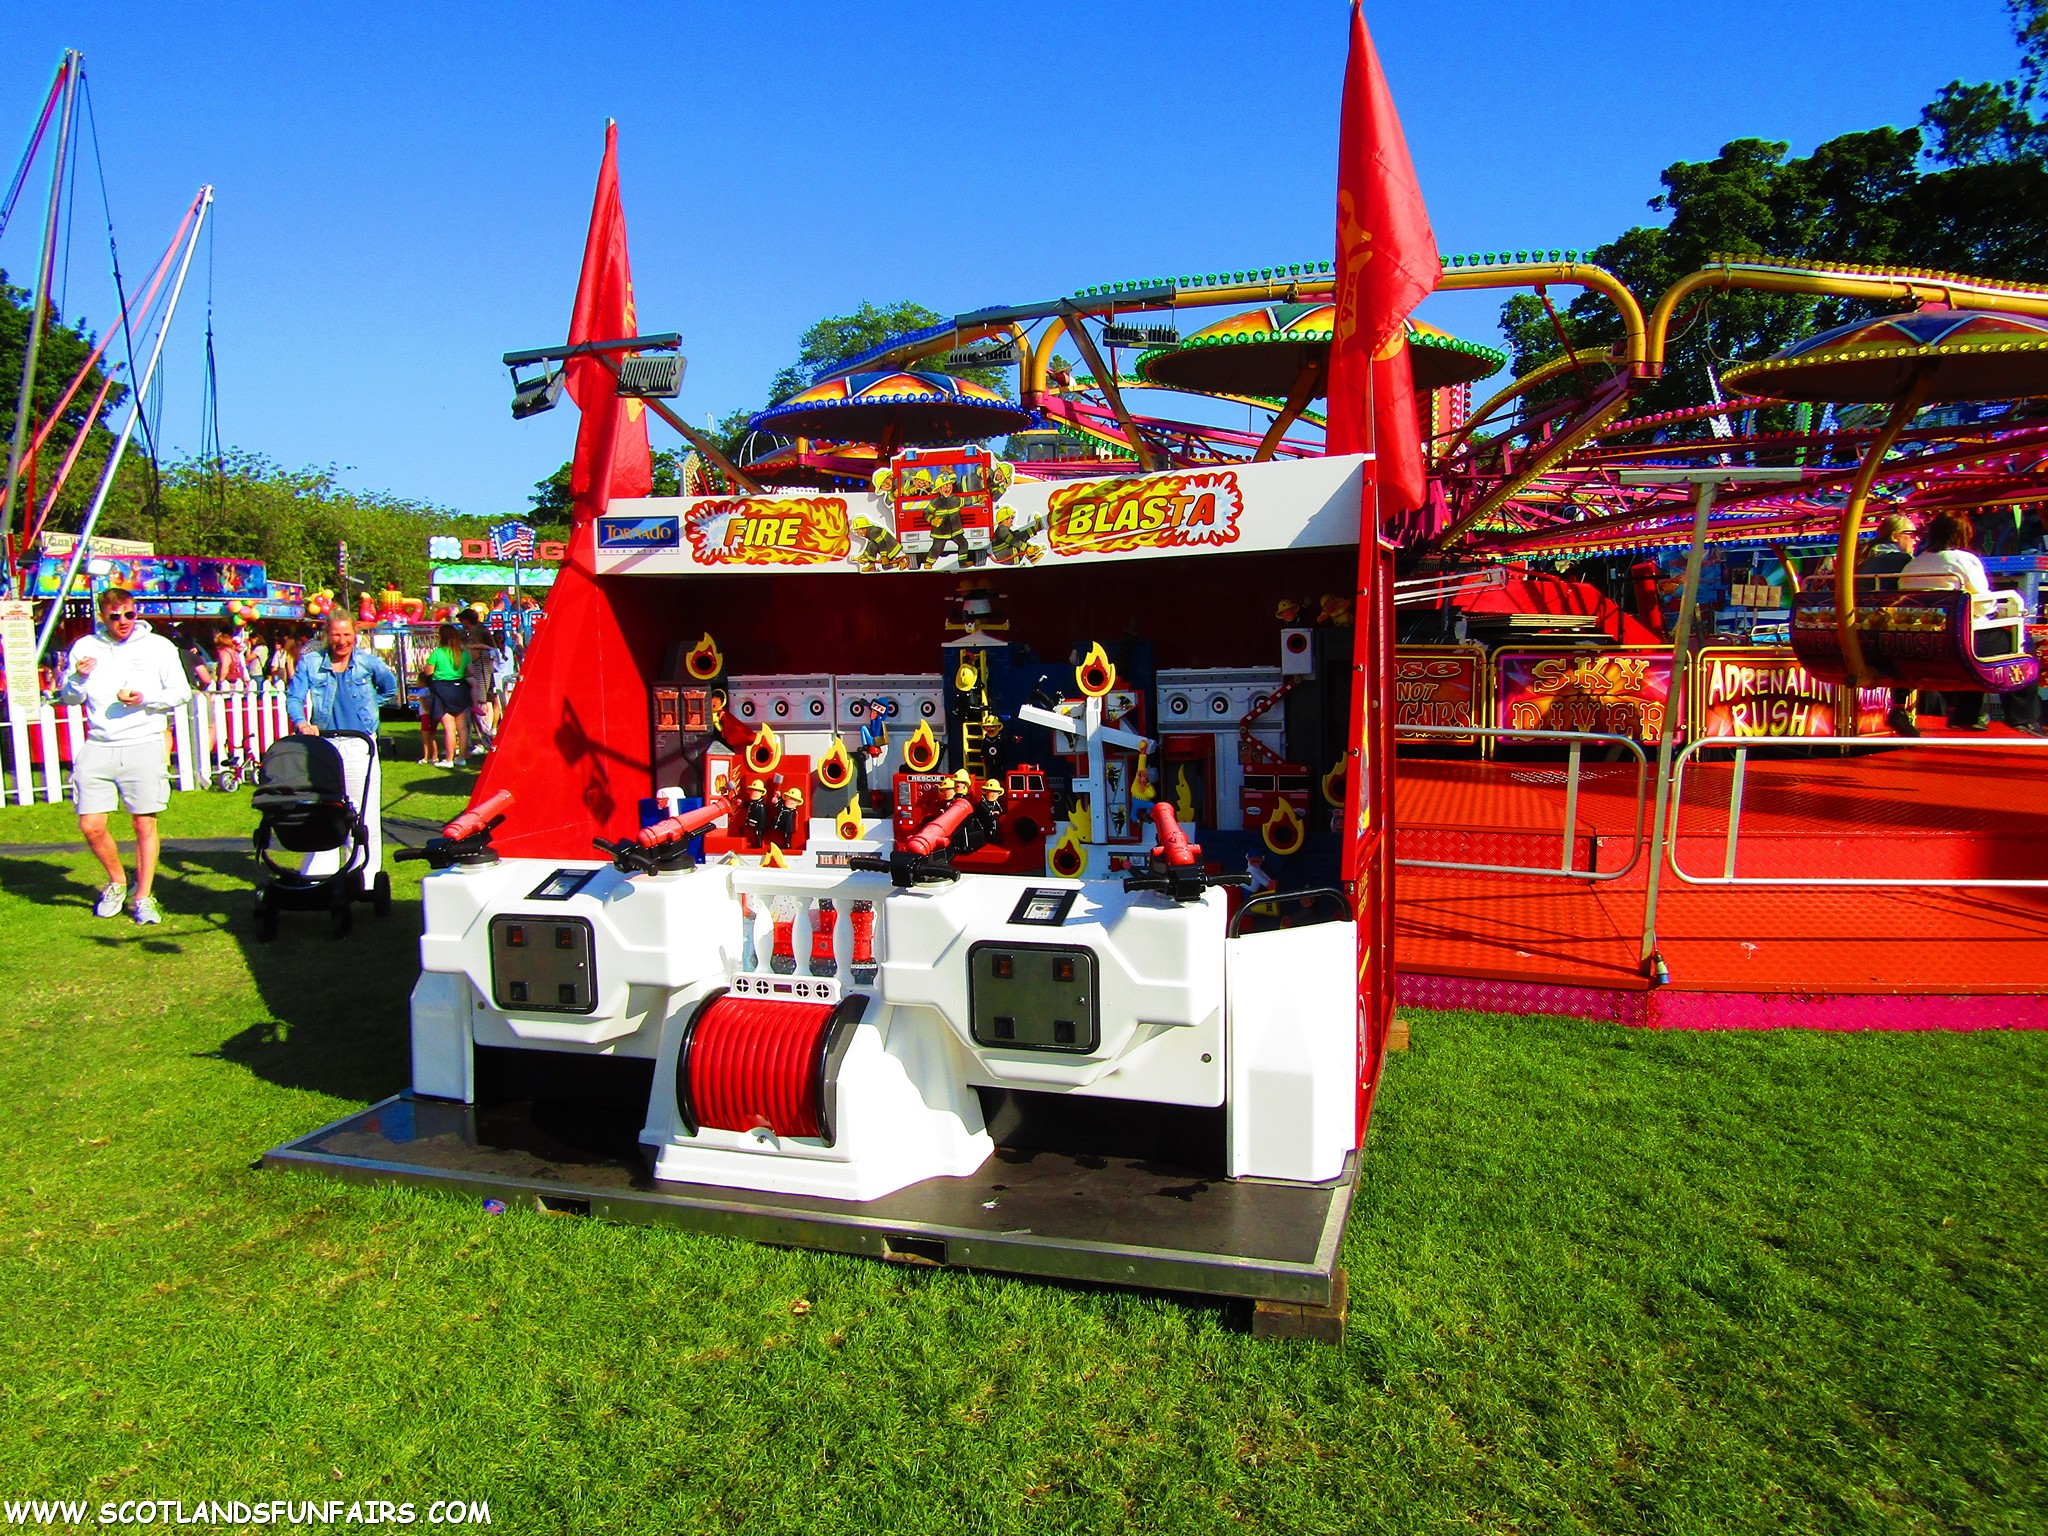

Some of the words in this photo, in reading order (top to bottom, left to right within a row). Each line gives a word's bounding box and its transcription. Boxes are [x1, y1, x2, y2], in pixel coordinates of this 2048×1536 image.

[1066, 492, 1216, 535] BLASTA
[723, 517, 802, 547] FIRE
[1396, 682, 1439, 701] NOT
[1531, 656, 1650, 693] SKY
[1398, 701, 1471, 737] CARS
[1512, 702, 1666, 741] DIVER
[1731, 700, 1809, 736] RUSH
